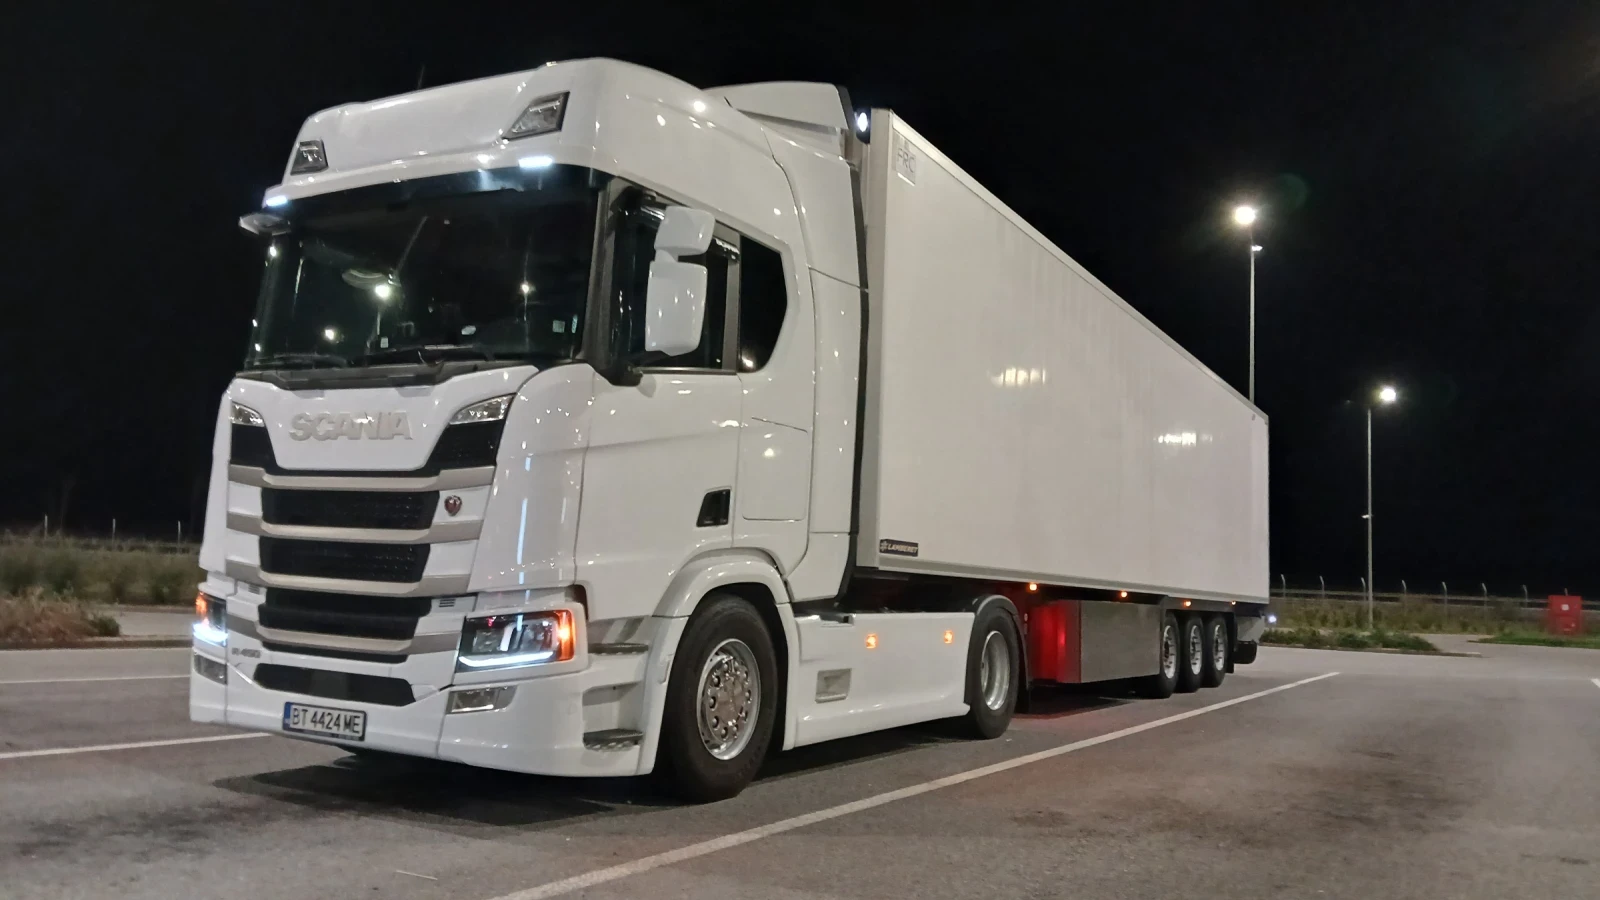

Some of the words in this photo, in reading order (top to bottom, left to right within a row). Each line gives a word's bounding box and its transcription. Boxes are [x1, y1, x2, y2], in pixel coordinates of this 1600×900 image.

[897, 147, 915, 173] FRC
[288, 411, 413, 441] SCANIA
[292, 707, 308, 726] BT
[310, 710, 341, 731] 4424
[343, 714, 361, 734] ME
